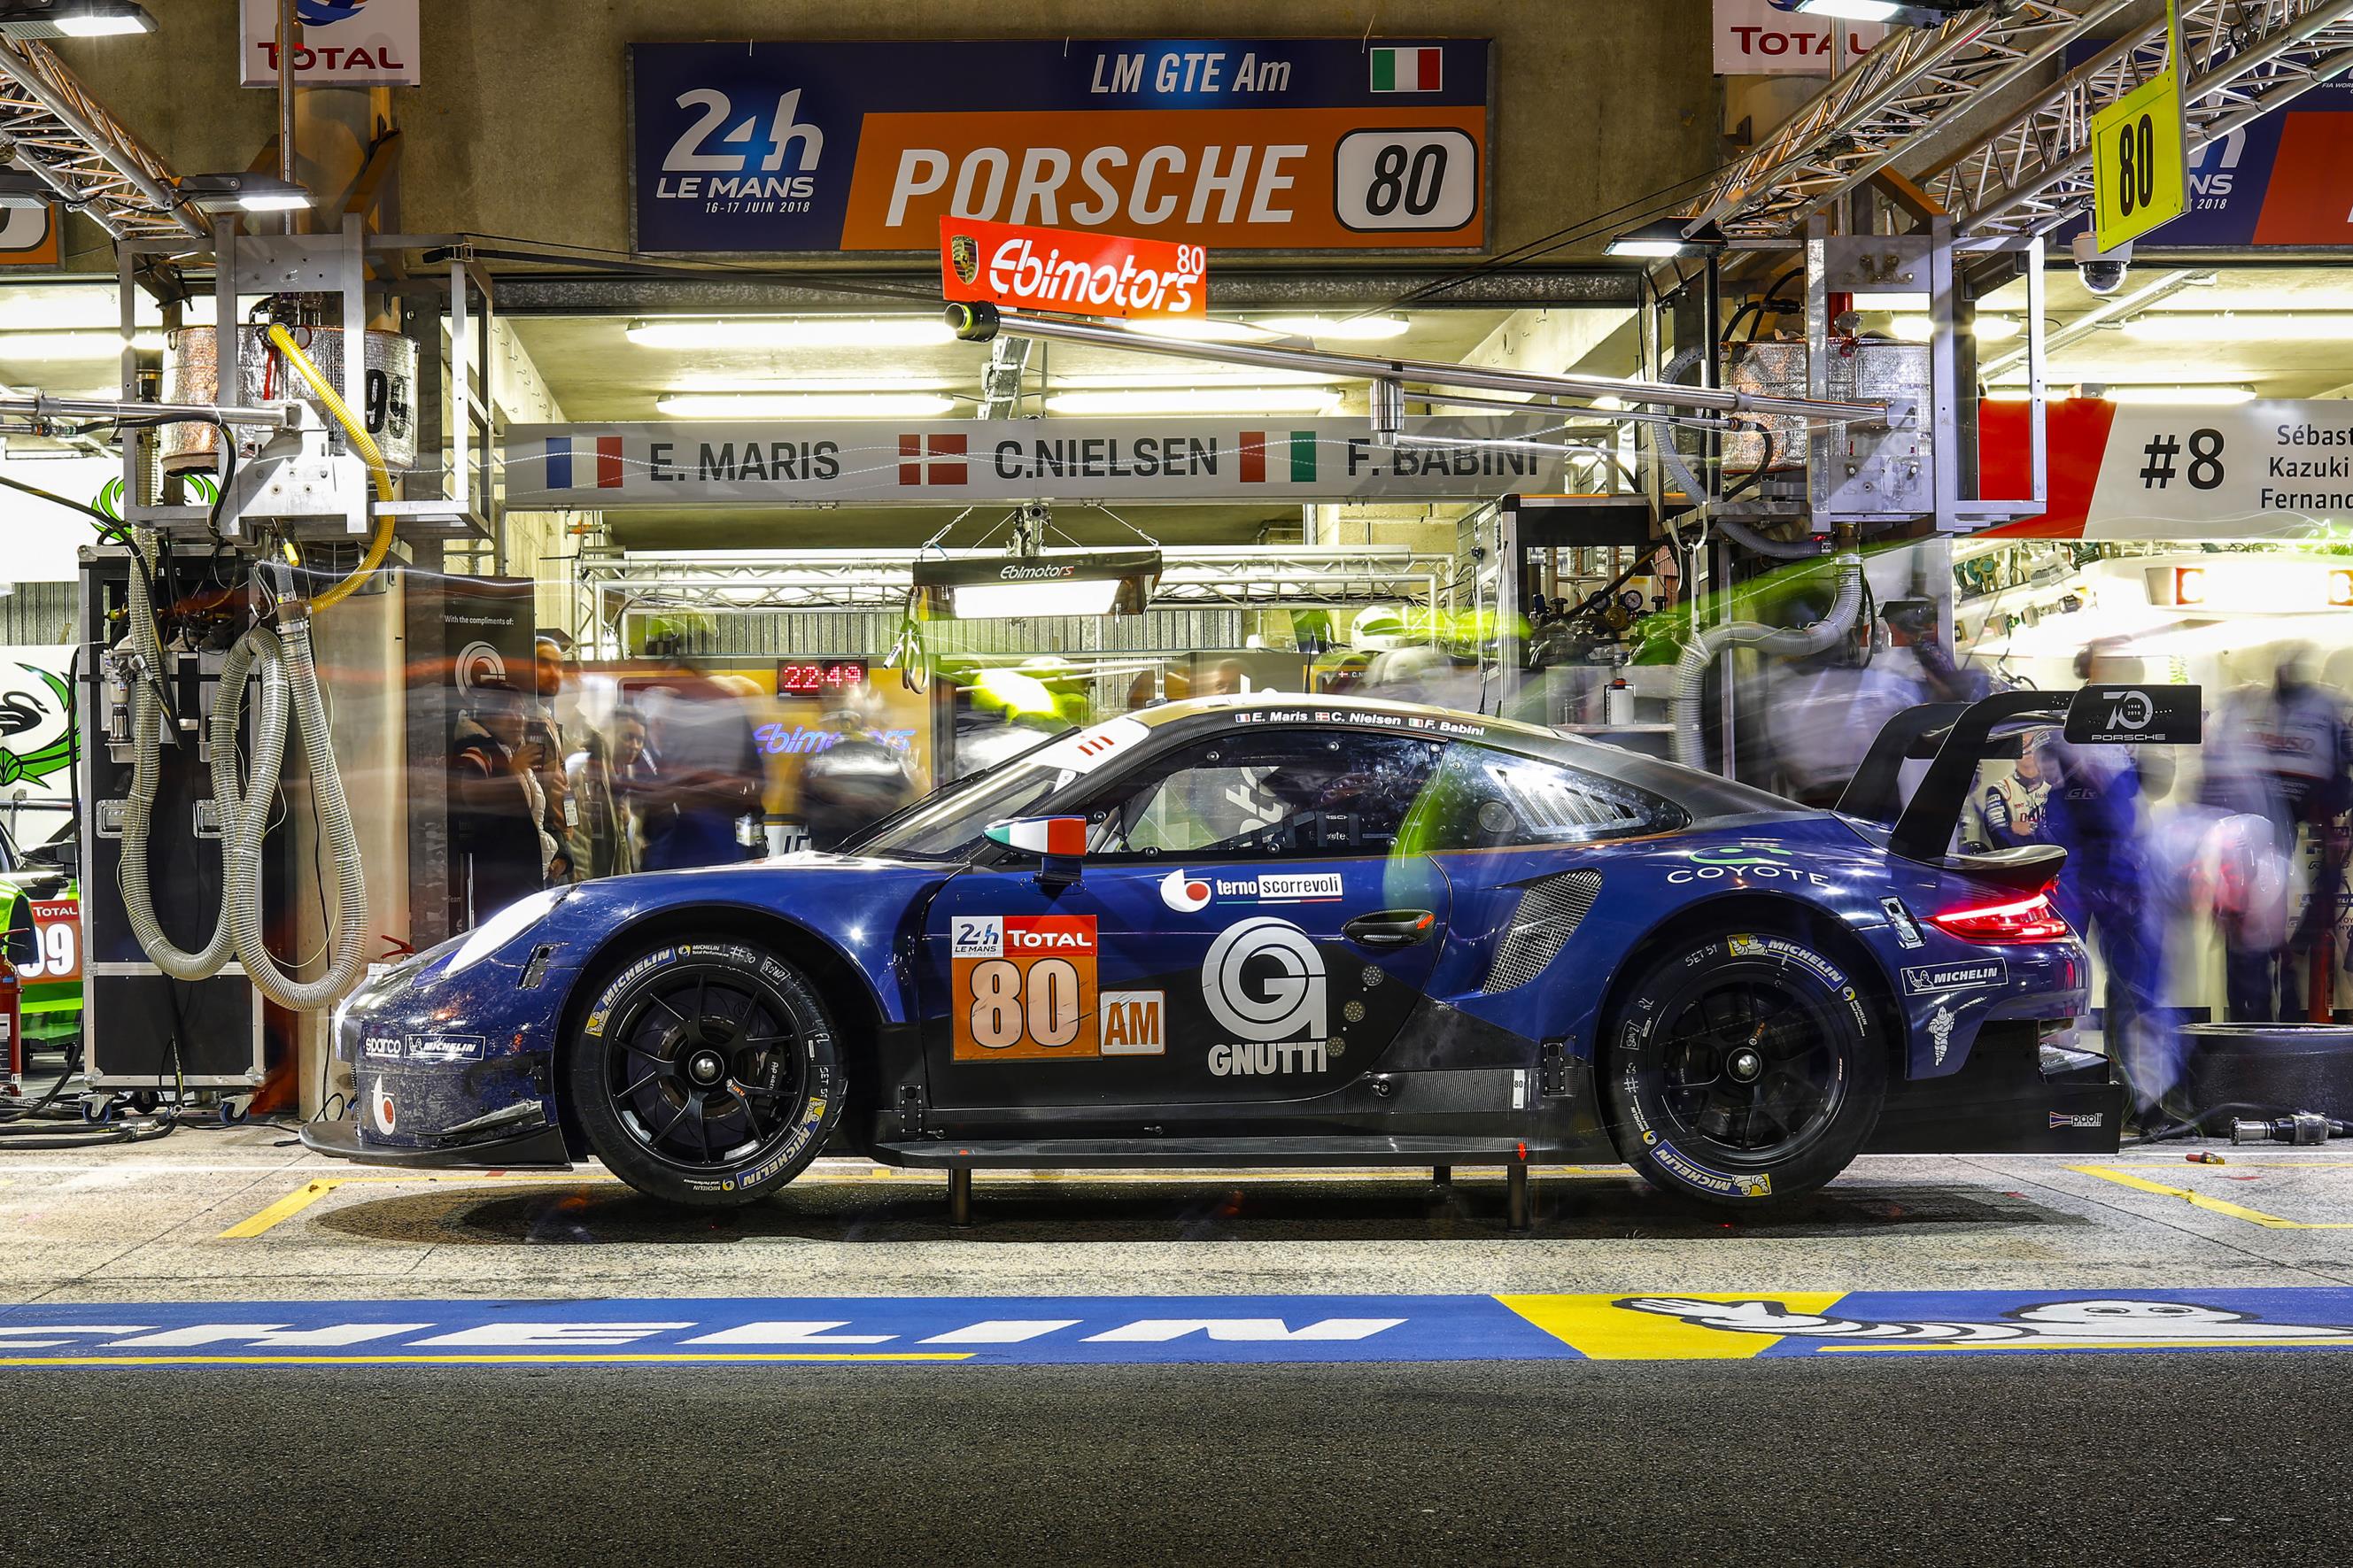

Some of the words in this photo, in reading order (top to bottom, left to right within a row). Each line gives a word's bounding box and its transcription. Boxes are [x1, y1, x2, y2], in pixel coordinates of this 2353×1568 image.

[1091, 54, 1145, 93] LM
[1155, 53, 1226, 93] GTE
[1232, 52, 1291, 92] Am
[662, 89, 824, 171] 24h
[2119, 113, 2153, 217] 80
[656, 177, 701, 198] LE
[708, 177, 814, 198] MANS
[886, 144, 1308, 227] PORSCHE
[1366, 144, 1447, 216] 80
[705, 202, 739, 213] 16-17
[745, 202, 775, 213] JUIN
[780, 202, 810, 213] 2018
[2197, 198, 2227, 209] 2018
[989, 239, 1198, 312] Ebimotors
[1177, 244, 1204, 274] 80
[651, 444, 685, 482] E.
[699, 441, 840, 482] MARIS
[1349, 438, 1379, 476] F.
[1393, 437, 1537, 476] BABINI
[2140, 429, 2225, 490] #8
[2269, 456, 2349, 477] Kazuki
[1252, 712, 1266, 722] E.
[1270, 711, 1308, 722] Maris
[1332, 712, 1345, 722] C.
[1349, 714, 1401, 725] Nielsen
[1425, 719, 1436, 730] F.
[1440, 722, 1484, 736] Babini
[1217, 879, 1257, 895] terno
[1263, 877, 1338, 892] scorrevoli
[1667, 866, 1831, 887] COYOTE
[33, 906, 78, 917] TOTAL
[956, 923, 999, 945] 24h
[1007, 930, 1092, 946] TOTAL
[1684, 949, 1706, 966] SET
[1769, 939, 1843, 983] MICHELIN
[602, 948, 671, 1006] MICHELIN
[1934, 967, 1998, 984] MICHELIN
[970, 958, 1080, 1048] 80
[1854, 1000, 1868, 1025] MICHELIN
[1104, 1001, 1159, 1046] AM
[366, 1037, 401, 1054] sparco
[423, 1042, 476, 1052] MICHELIN
[1208, 1042, 1327, 1076] GNUTTI
[819, 1067, 829, 1085] SET
[2073, 1113, 2101, 1126] paoli
[743, 1127, 811, 1186] MICHELIN
[1656, 1149, 1733, 1191] MICHELIN
